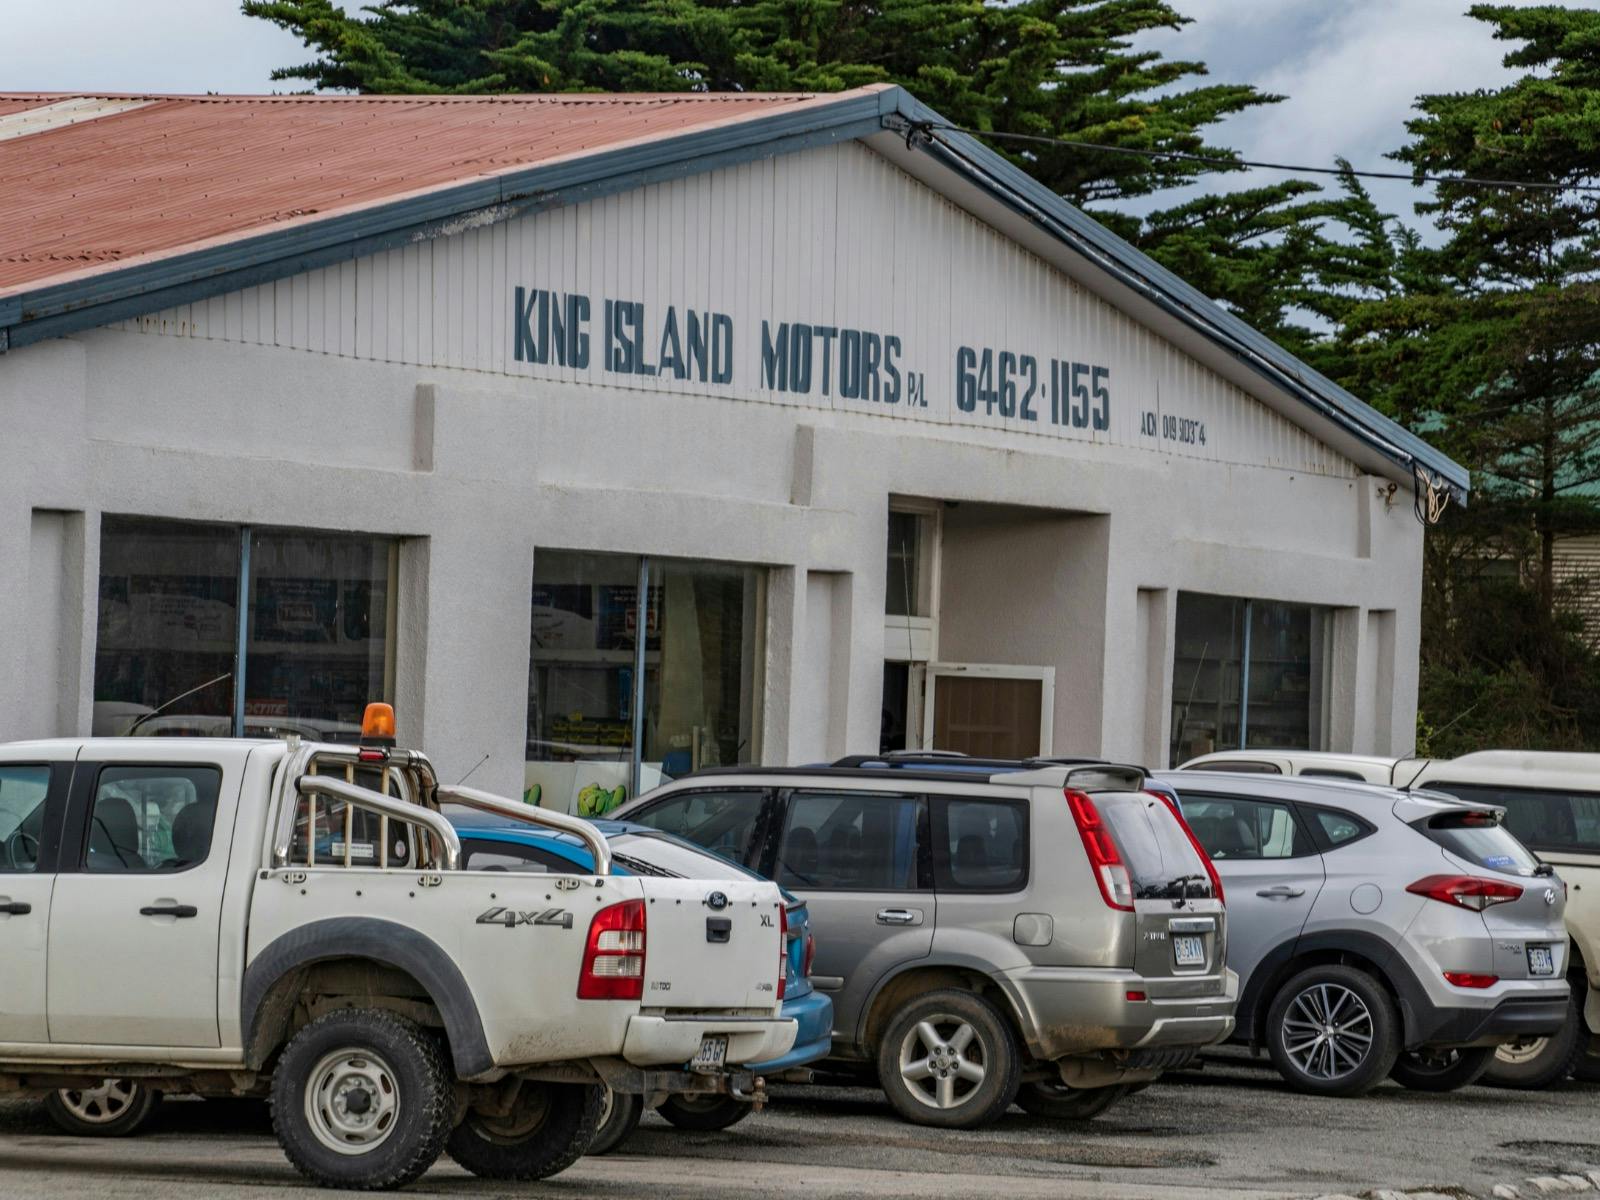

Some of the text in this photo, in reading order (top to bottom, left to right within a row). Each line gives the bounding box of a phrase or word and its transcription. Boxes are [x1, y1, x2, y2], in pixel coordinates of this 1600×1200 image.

[514, 286, 590, 370] KING
[604, 299, 733, 385] ISLAND
[761, 319, 902, 404] MOTORS
[760, 914, 774, 928] XL
